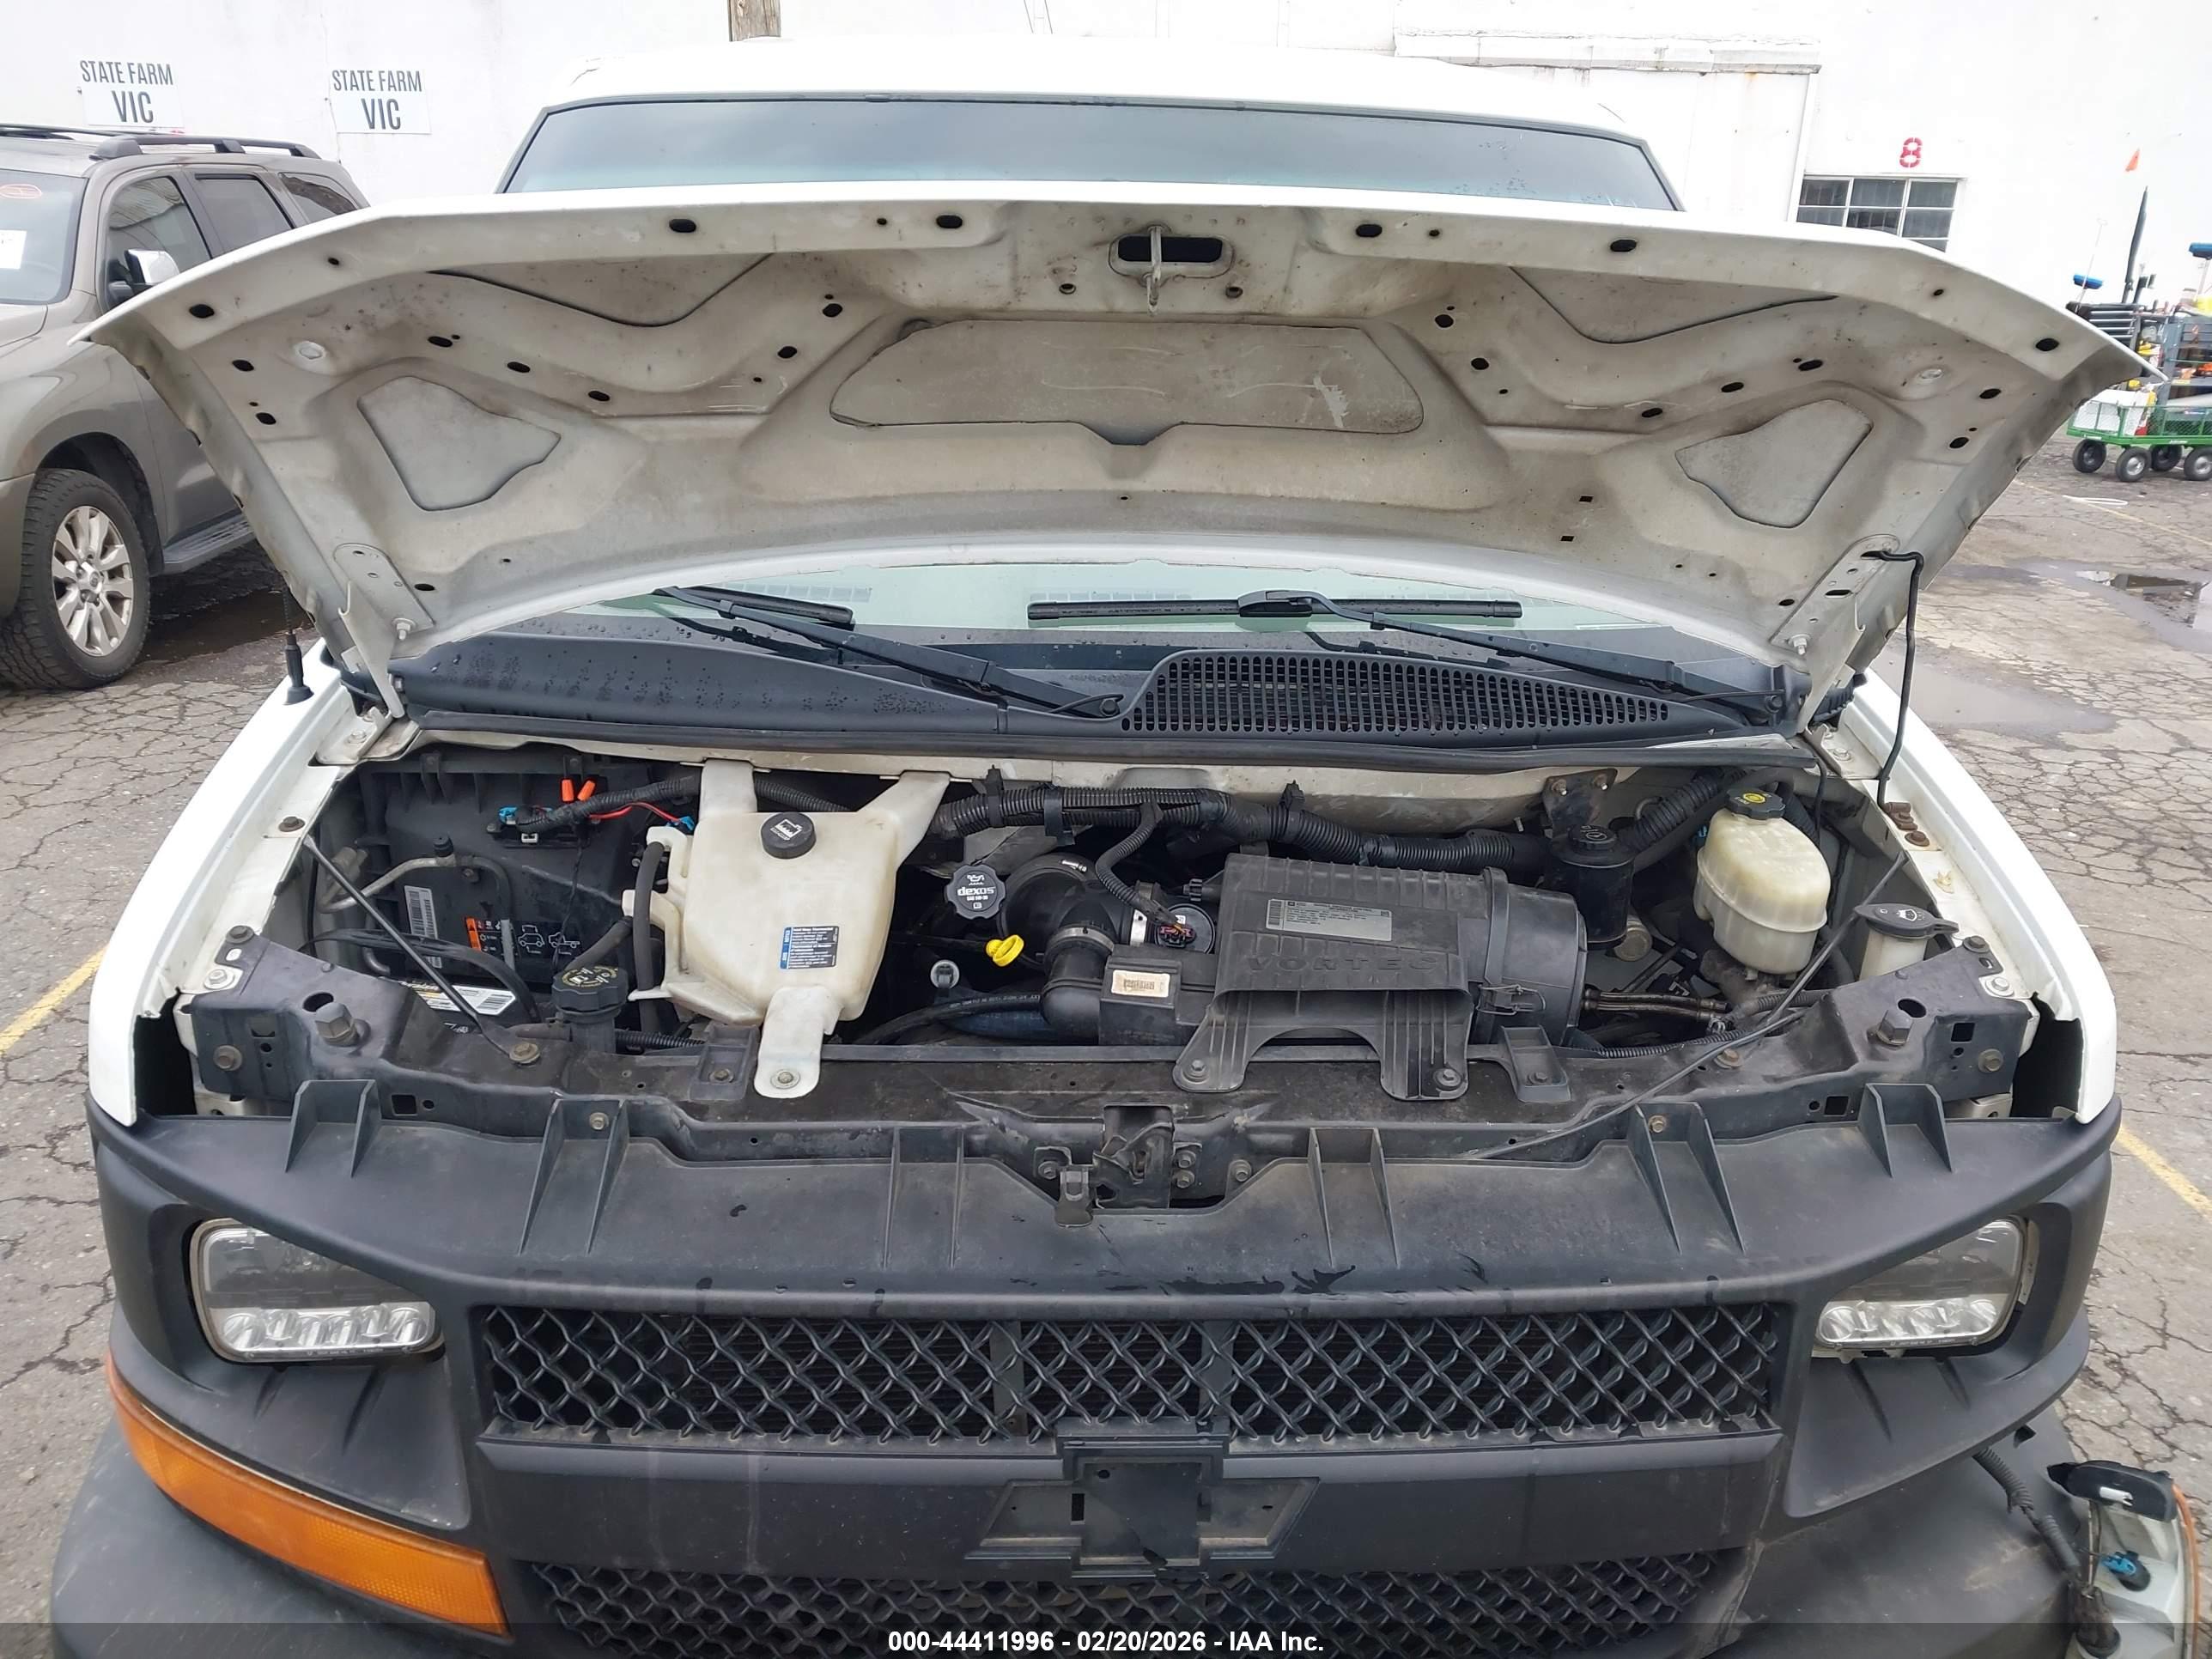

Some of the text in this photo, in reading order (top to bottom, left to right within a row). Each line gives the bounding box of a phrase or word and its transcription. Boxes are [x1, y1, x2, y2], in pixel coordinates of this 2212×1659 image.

[80, 59, 174, 86] STATE FARM
[331, 69, 422, 93] STATE FARM
[111, 89, 154, 124] VIC
[361, 97, 401, 131] VIC
[1899, 137, 1923, 168] 8
[956, 885, 997, 896] dexos
[1247, 956, 1438, 972] VORTEC
